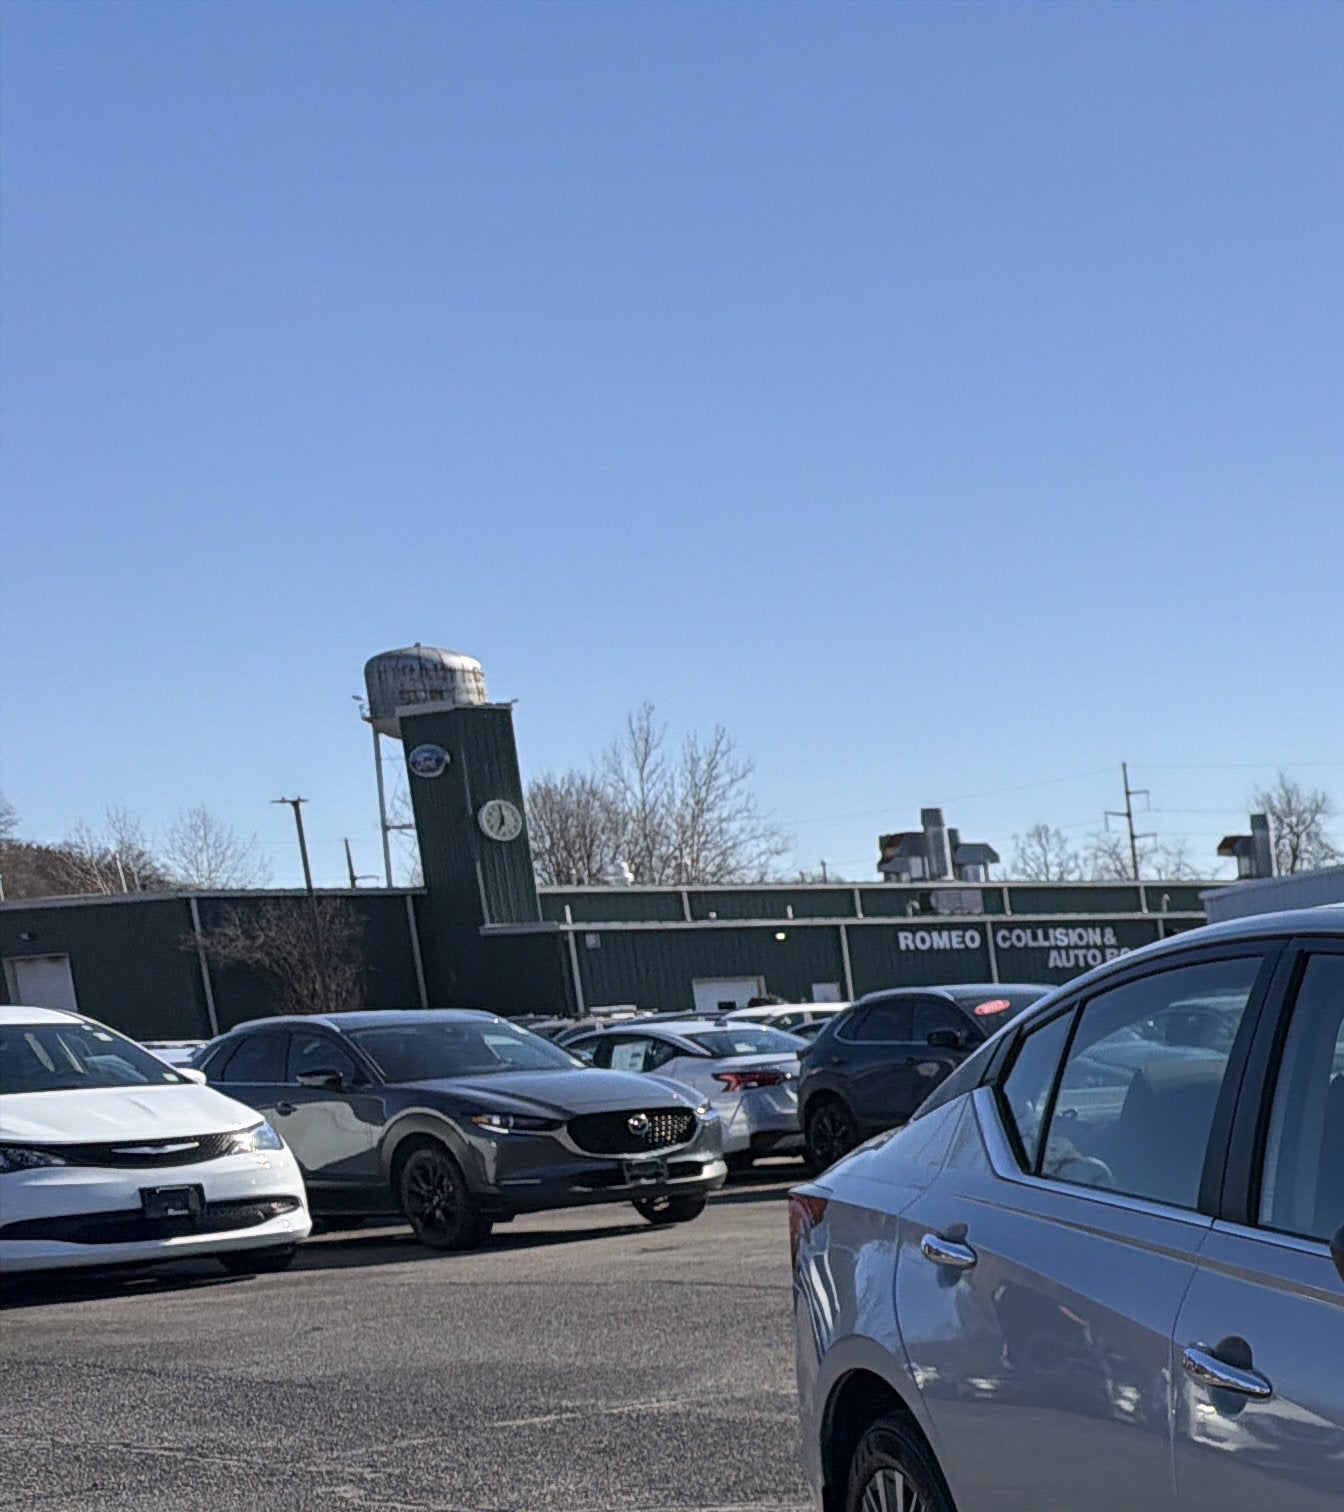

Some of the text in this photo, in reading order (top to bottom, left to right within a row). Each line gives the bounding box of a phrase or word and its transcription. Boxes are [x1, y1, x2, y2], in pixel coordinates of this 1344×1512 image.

[898, 926, 1118, 951] ROMEO COLLISION &
[1048, 948, 1102, 969] AUTO
